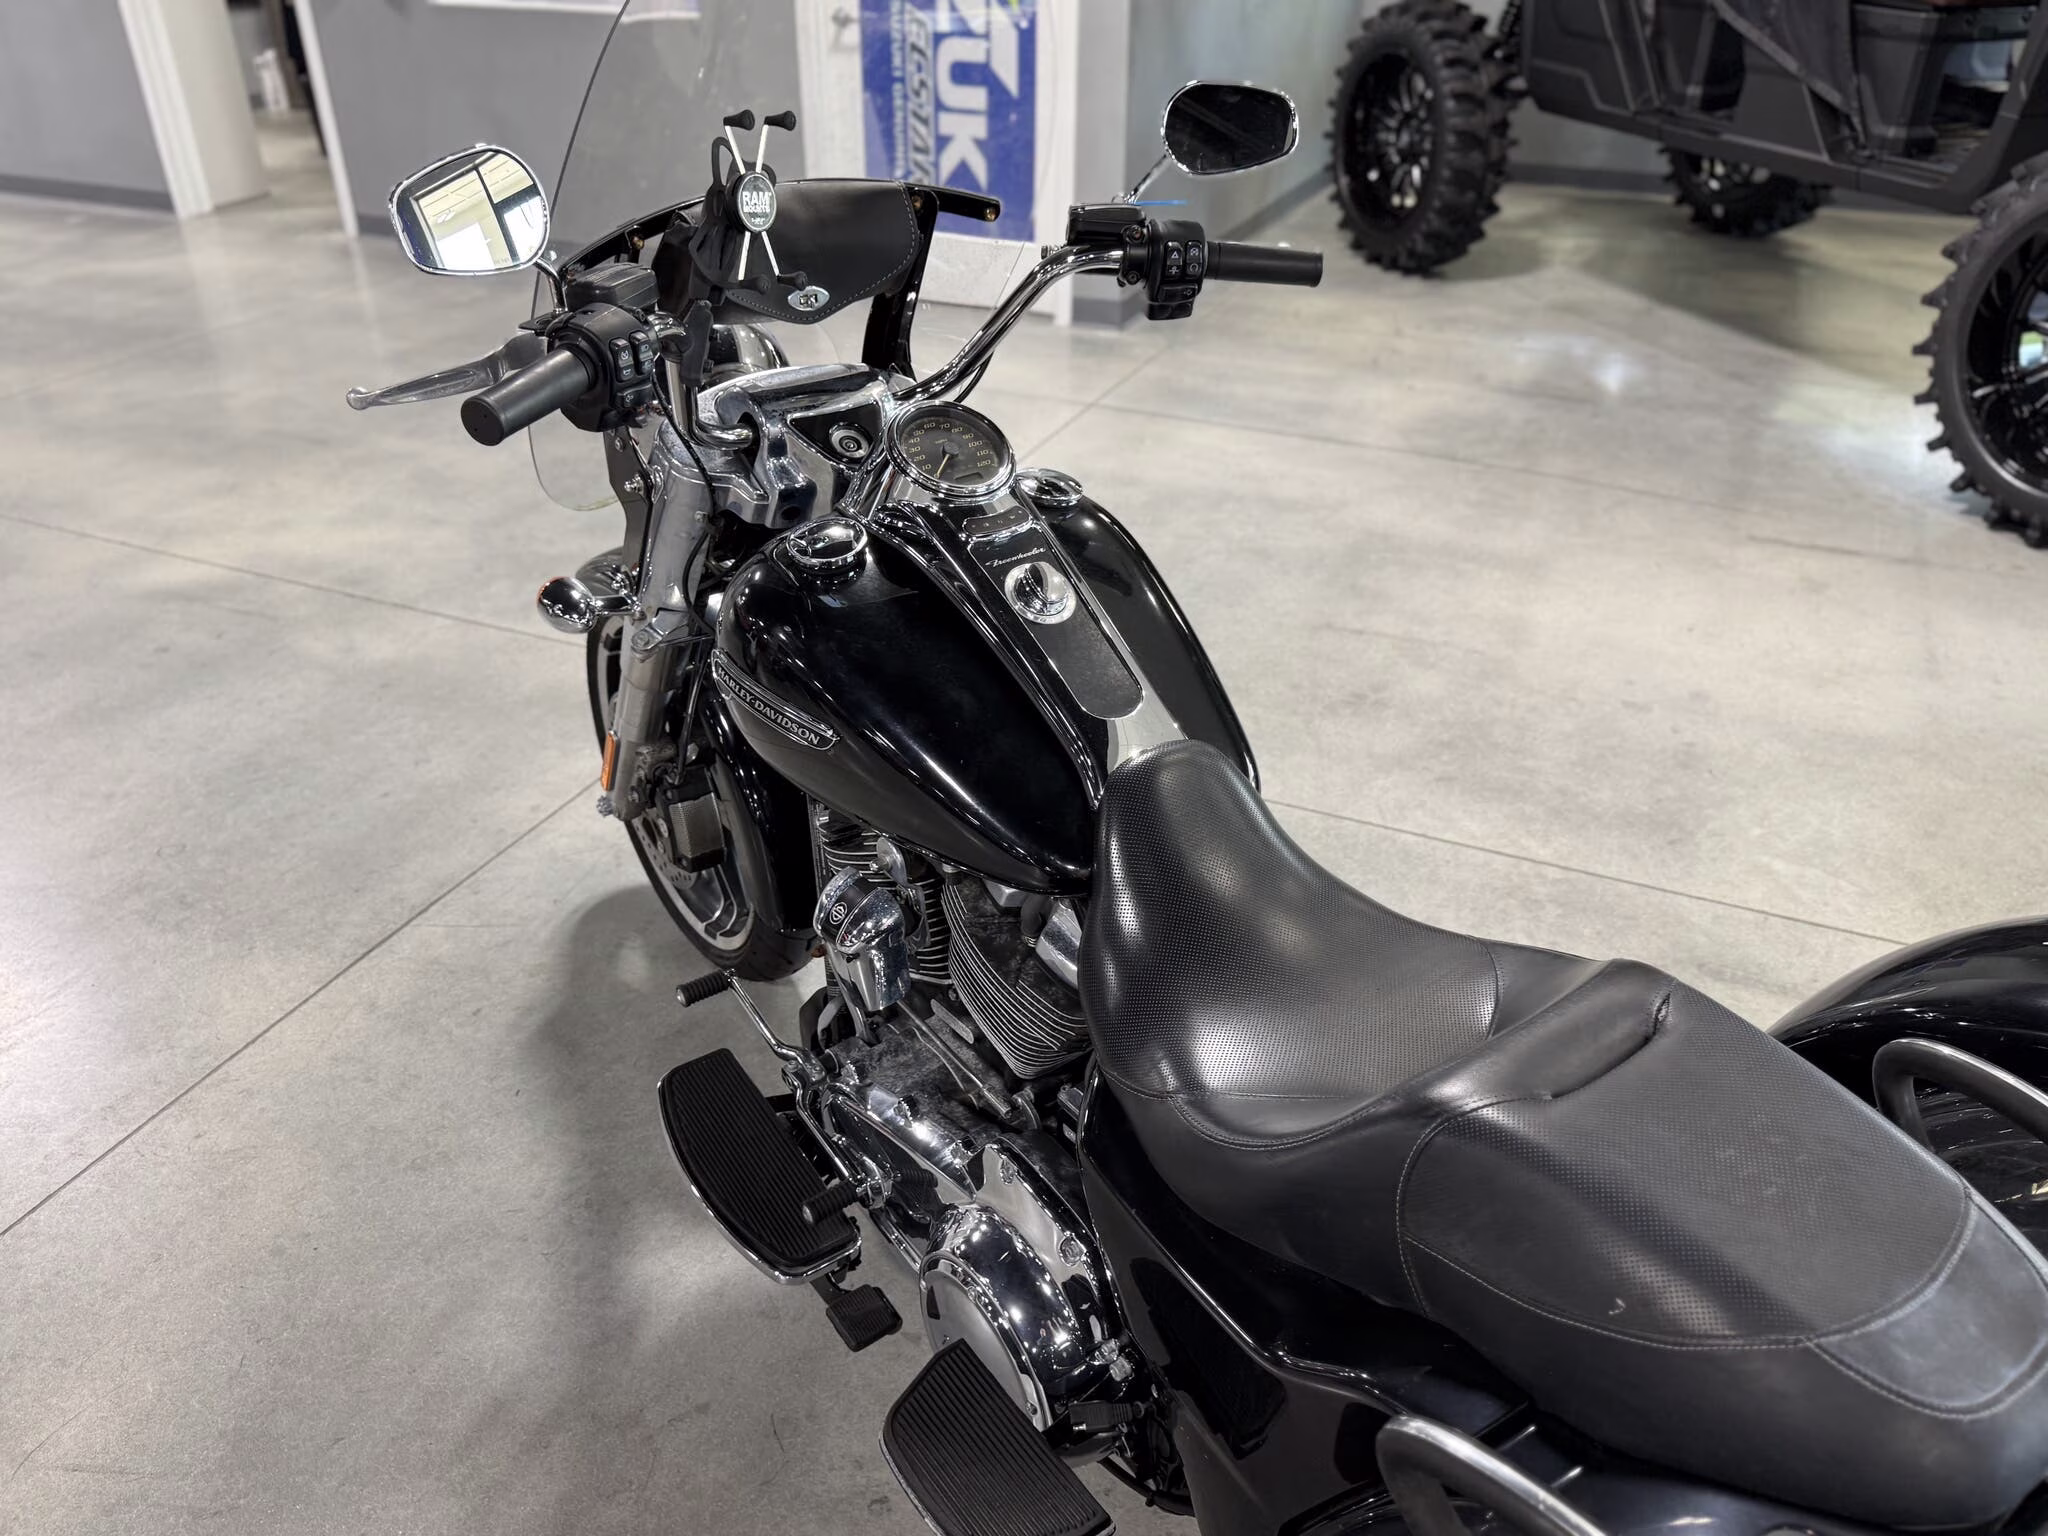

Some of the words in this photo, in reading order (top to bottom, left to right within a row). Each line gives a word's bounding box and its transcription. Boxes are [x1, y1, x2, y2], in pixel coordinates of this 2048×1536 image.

[742, 191, 770, 205] RAM
[968, 440, 983, 448] 100
[922, 463, 932, 471] 10
[977, 459, 991, 467] 120
[717, 667, 821, 745] HARLEY-DAVIDSON
